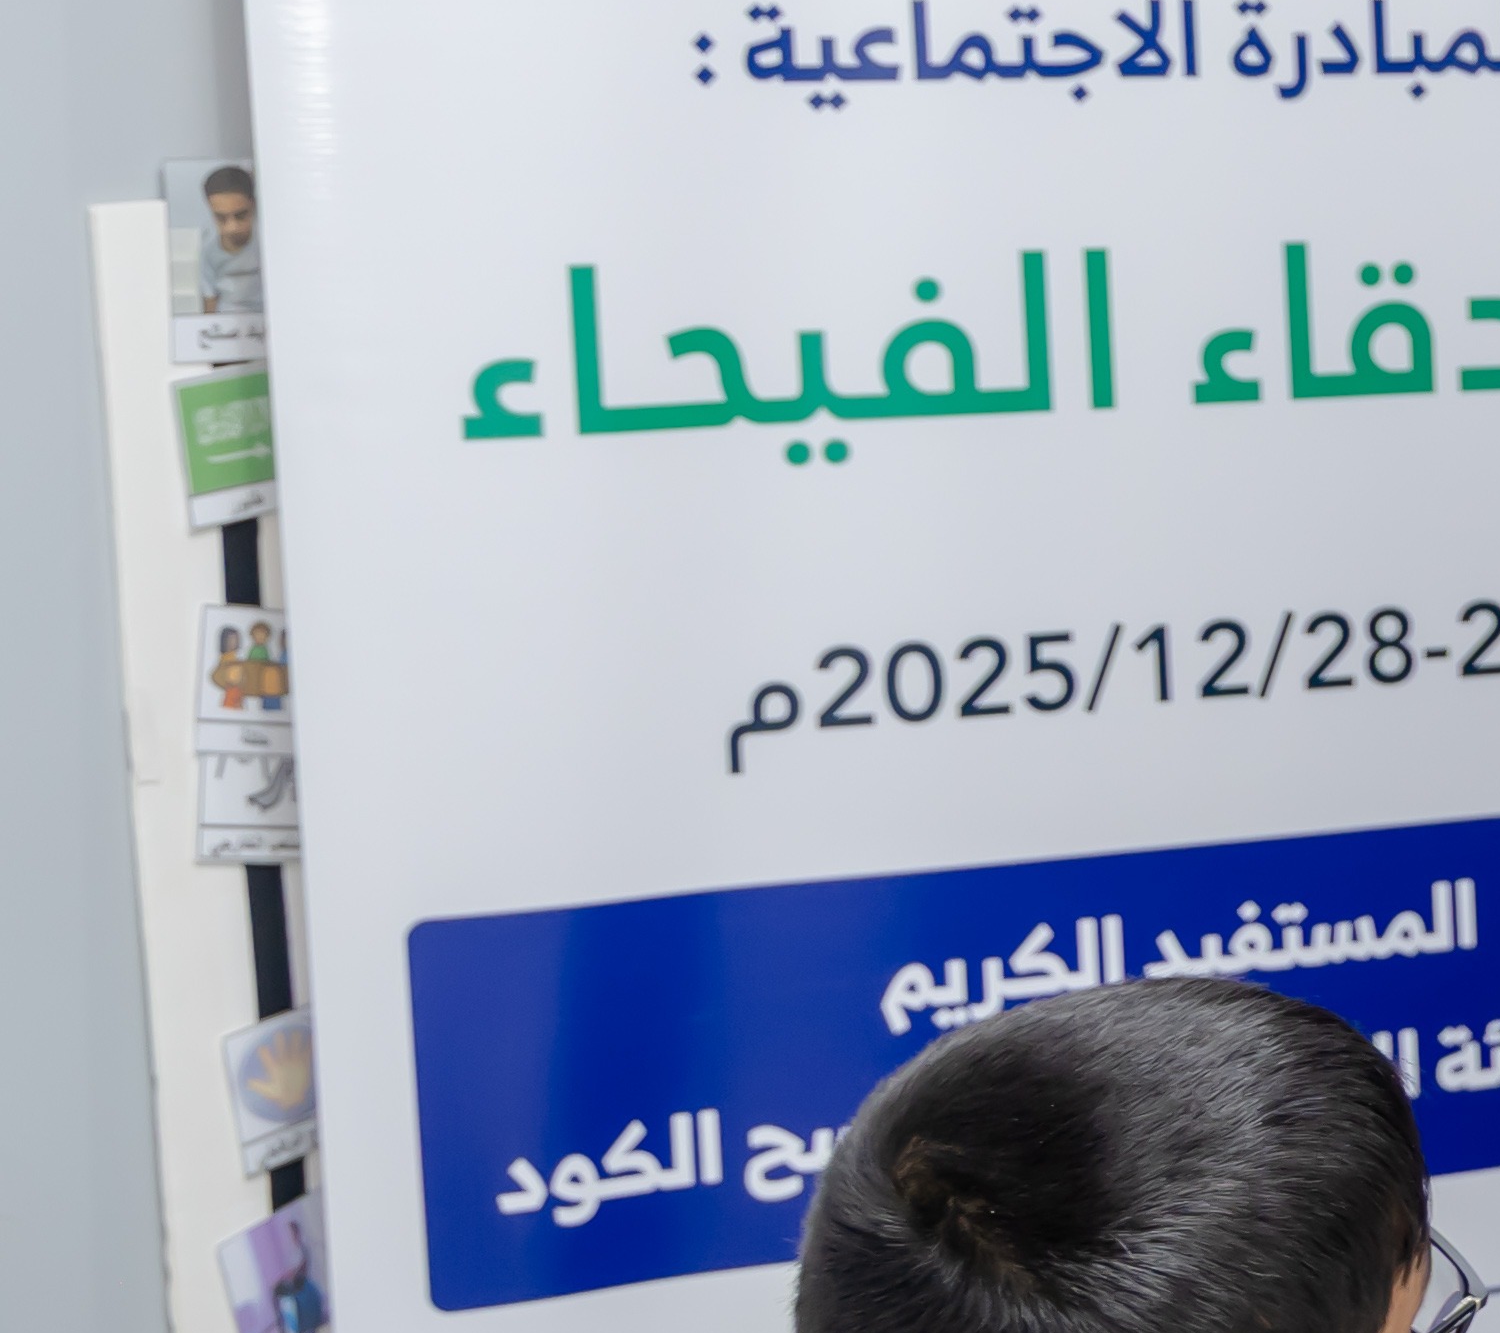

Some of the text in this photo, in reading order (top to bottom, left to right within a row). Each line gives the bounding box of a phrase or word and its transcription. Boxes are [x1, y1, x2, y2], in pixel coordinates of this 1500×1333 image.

[463, 249, 1114, 465] الفيحاء
[880, 914, 1125, 1035] الكريم
[496, 1108, 723, 1226] الكود
